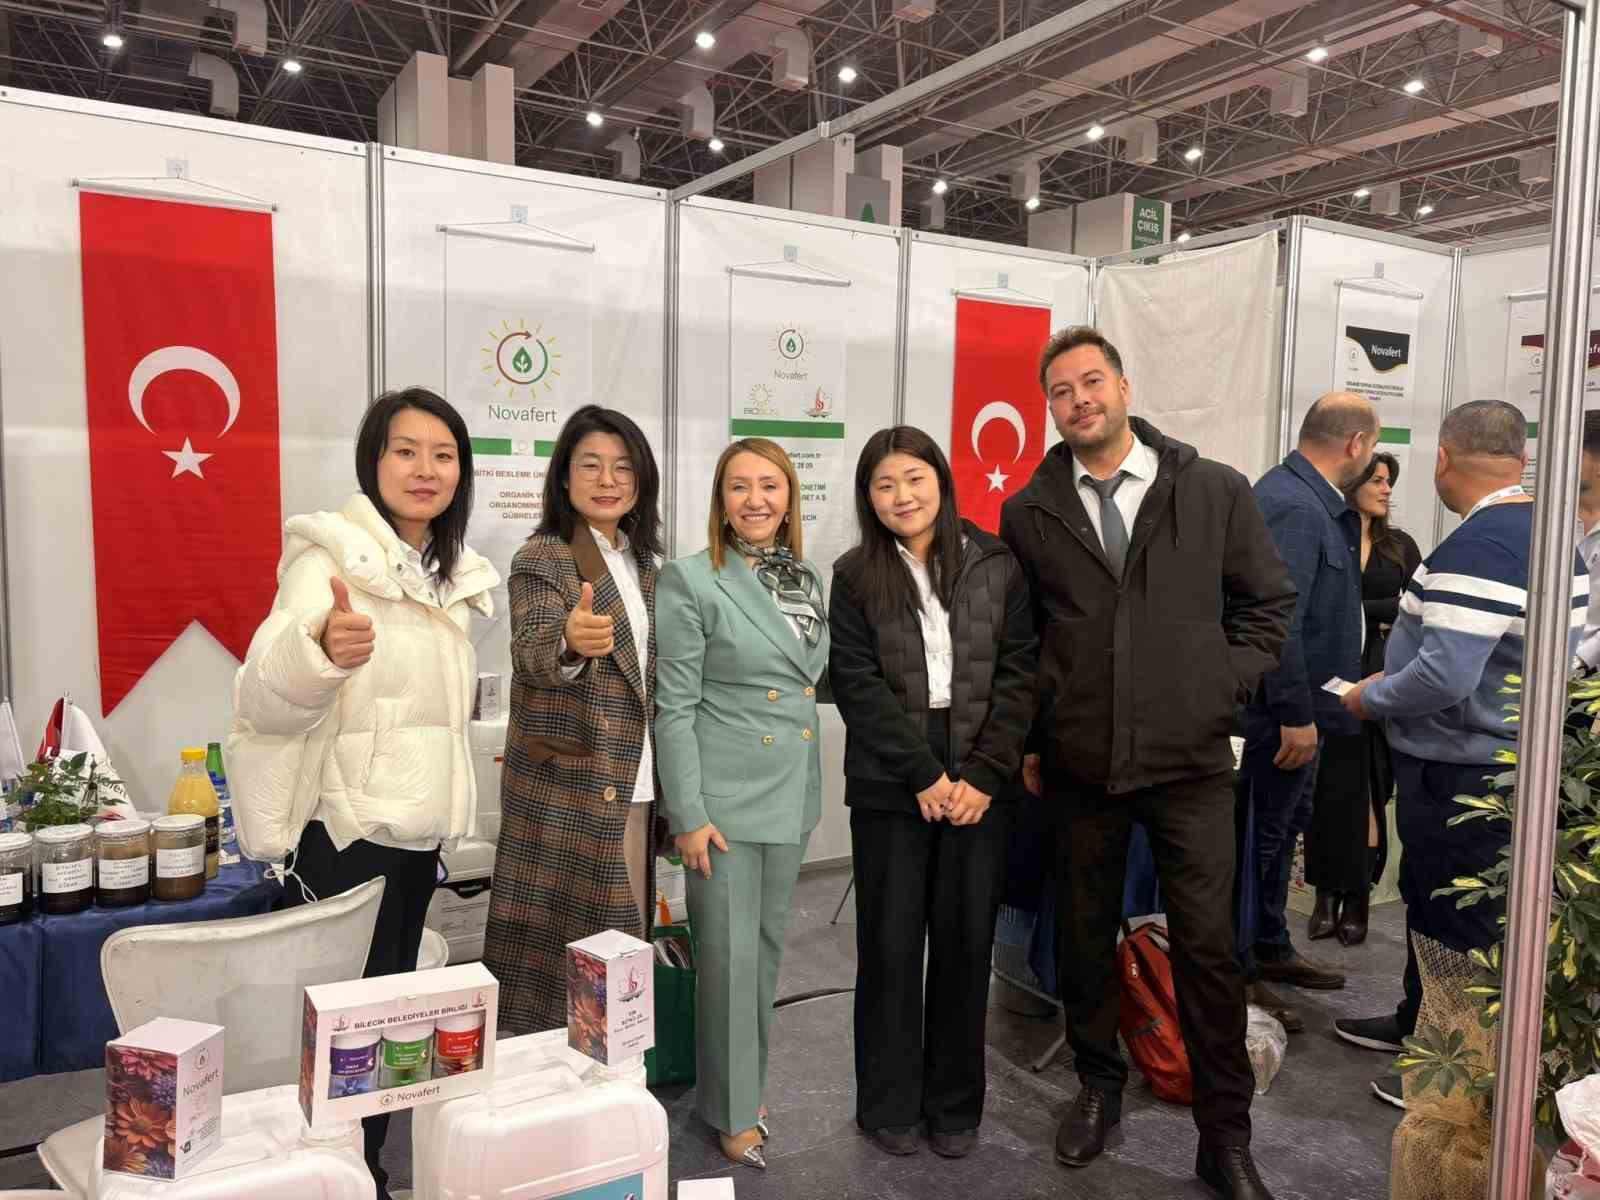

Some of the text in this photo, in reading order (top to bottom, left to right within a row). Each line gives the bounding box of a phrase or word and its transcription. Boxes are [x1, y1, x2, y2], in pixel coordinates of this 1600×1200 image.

[1371, 344, 1401, 358] Novafert
[773, 369, 808, 380] Novafert
[488, 404, 557, 424] Novafert
[354, 1017, 387, 1030] BİLECİK
[387, 1009, 440, 1023] BELEDİYELER
[182, 1069, 220, 1097] Novafert
[396, 1085, 441, 1102] Novafert
